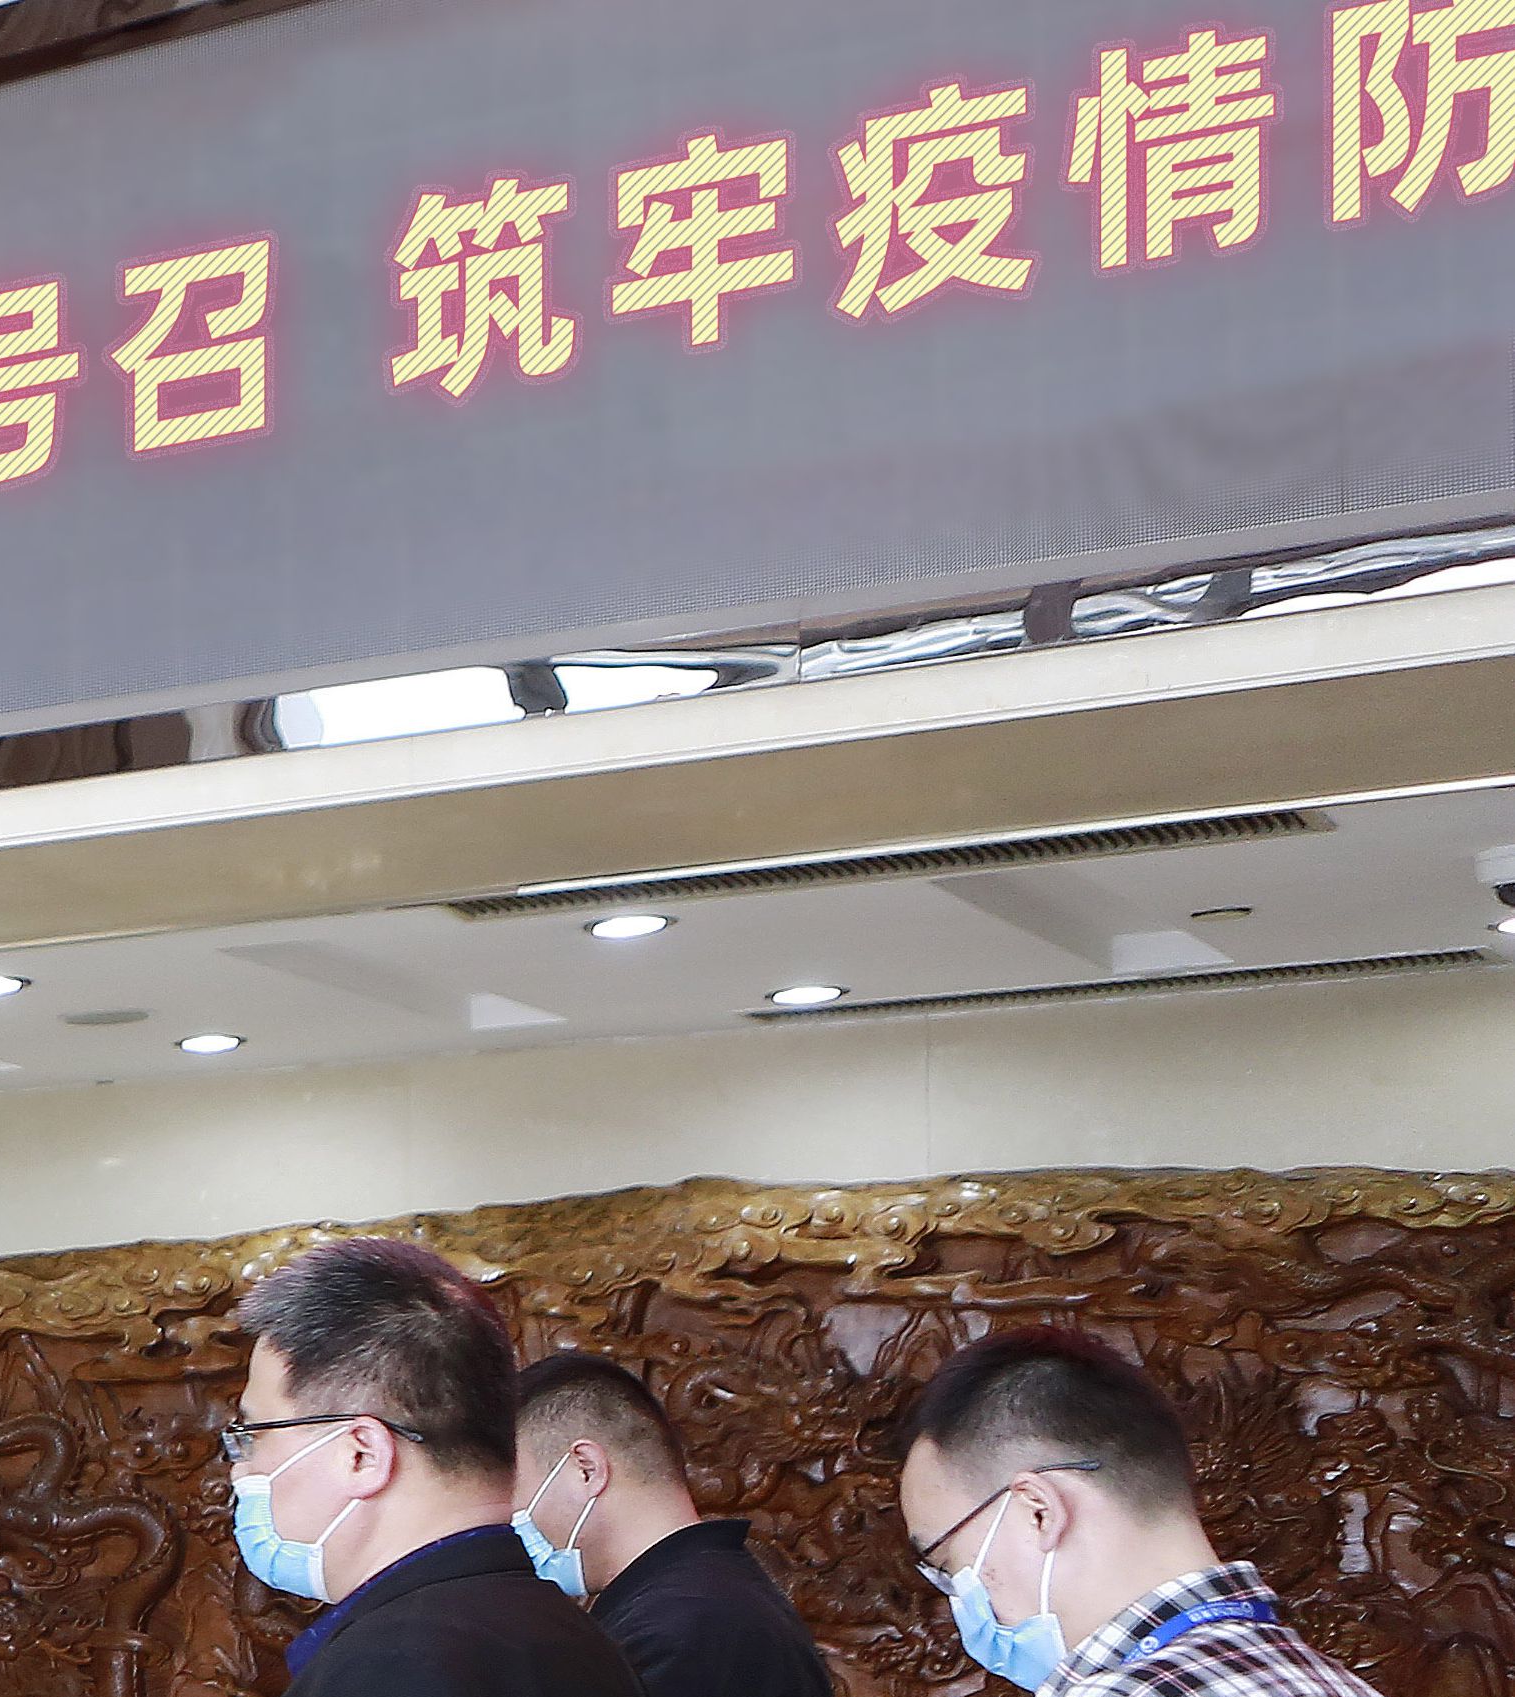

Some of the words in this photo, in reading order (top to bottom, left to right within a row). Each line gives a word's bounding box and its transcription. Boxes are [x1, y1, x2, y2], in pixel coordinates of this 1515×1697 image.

[389, 0, 1515, 398] 筑牢疫情防
